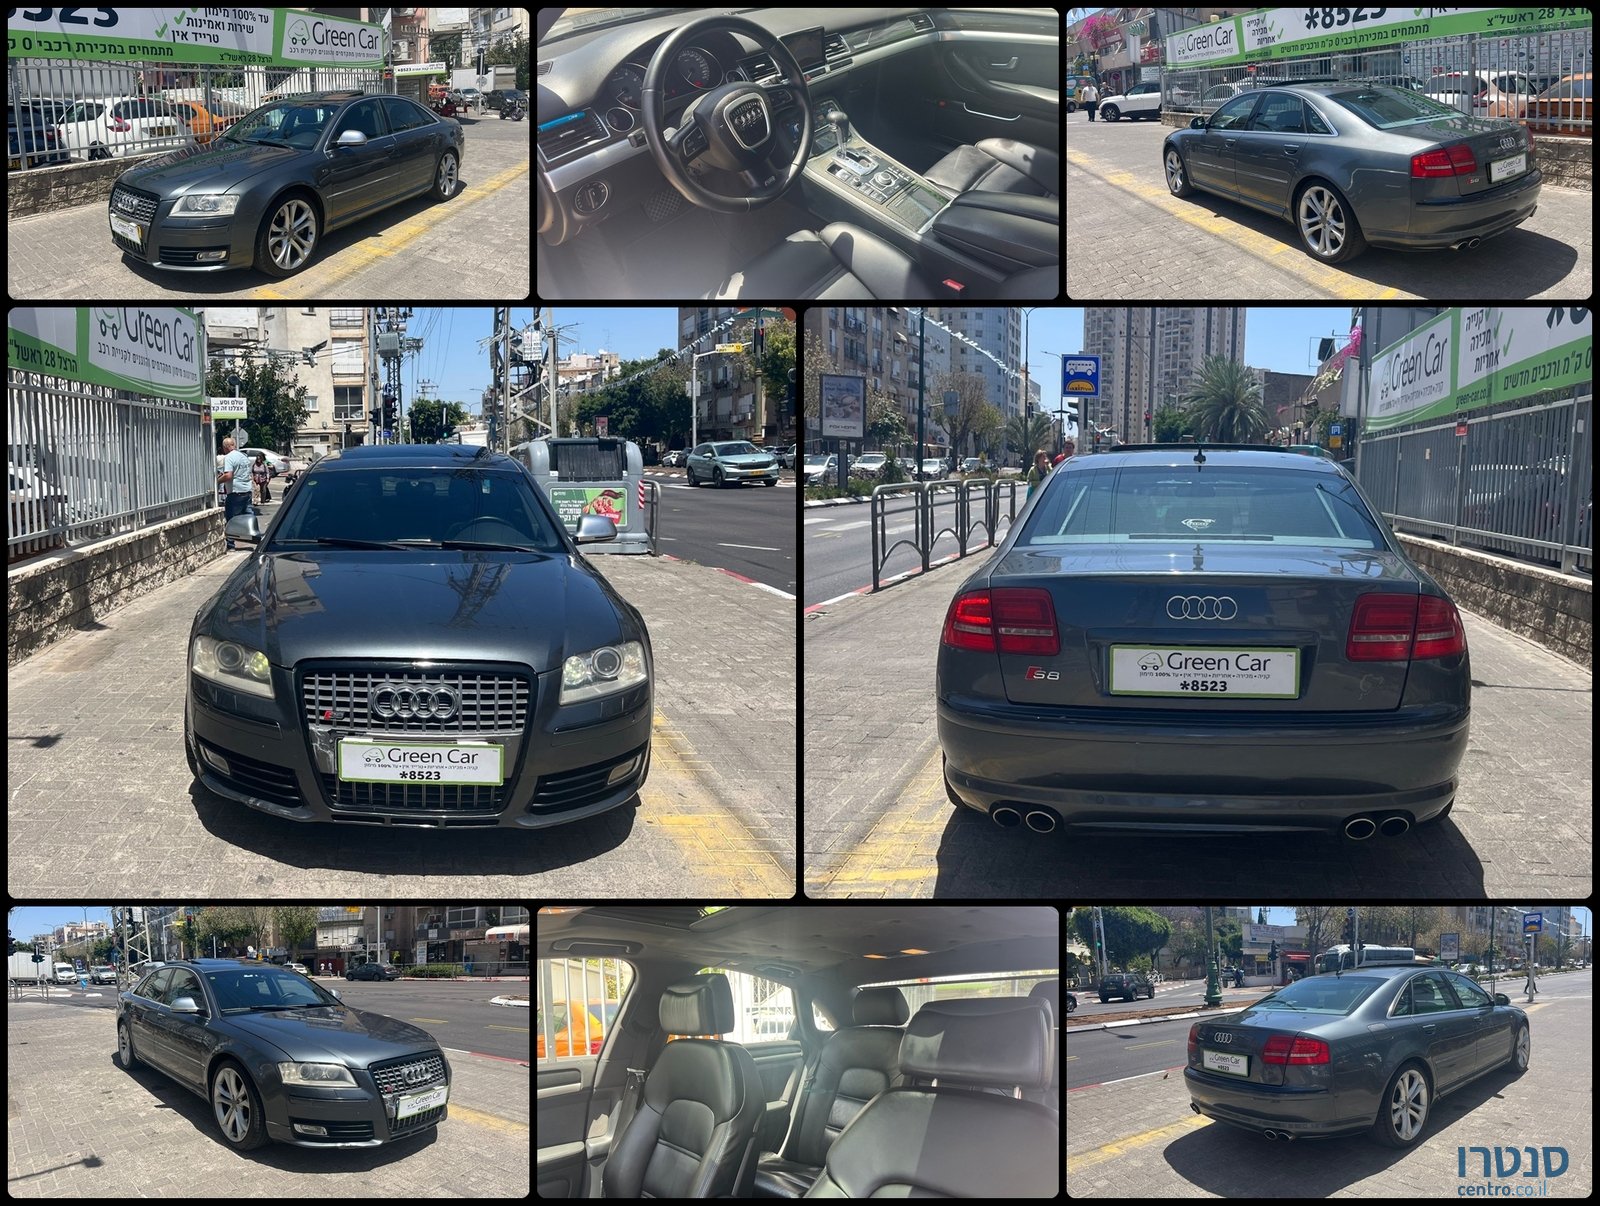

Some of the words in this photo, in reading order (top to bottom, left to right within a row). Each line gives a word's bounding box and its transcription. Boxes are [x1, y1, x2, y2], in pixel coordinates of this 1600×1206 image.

[204, 8, 229, 18] מימון
[232, 9, 256, 22] 100%
[258, 14, 269, 24] עד
[1538, 9, 1555, 20] 28
[186, 17, 225, 31] ואמינות
[228, 22, 254, 34] שירות
[1391, 23, 1429, 38] מתמחים
[171, 30, 188, 43] אין
[192, 31, 219, 43] טרייד
[312, 21, 356, 48] Green
[358, 28, 379, 50] Car
[1187, 34, 1213, 51] Green
[1215, 27, 1233, 46] Car
[1335, 38, 1340, 46] 0
[1340, 35, 1357, 46] רכבי
[1358, 29, 1389, 43] במכירת
[22, 37, 32, 50] 0
[37, 40, 71, 52] רכבי
[76, 42, 125, 54] במכירת
[1281, 44, 1299, 53] חדשים
[129, 45, 173, 56] מתמחים
[124, 307, 172, 355] Green
[174, 317, 194, 364] Car
[1470, 329, 1491, 352] מכירה
[8, 338, 42, 365] ראשל"
[98, 342, 110, 355] רכב
[44, 349, 56, 368] 28
[57, 352, 77, 373] הרצל
[1392, 352, 1422, 391] Green
[1425, 333, 1447, 377] Car
[1474, 348, 1500, 373] אחריות
[1531, 359, 1560, 383] ורכבים
[1503, 368, 1530, 391] חדשים
[1167, 652, 1229, 671] Green
[1235, 653, 1271, 671] Car
[1033, 670, 1060, 680] S8
[388, 748, 442, 763] Green
[447, 749, 478, 764] Car
